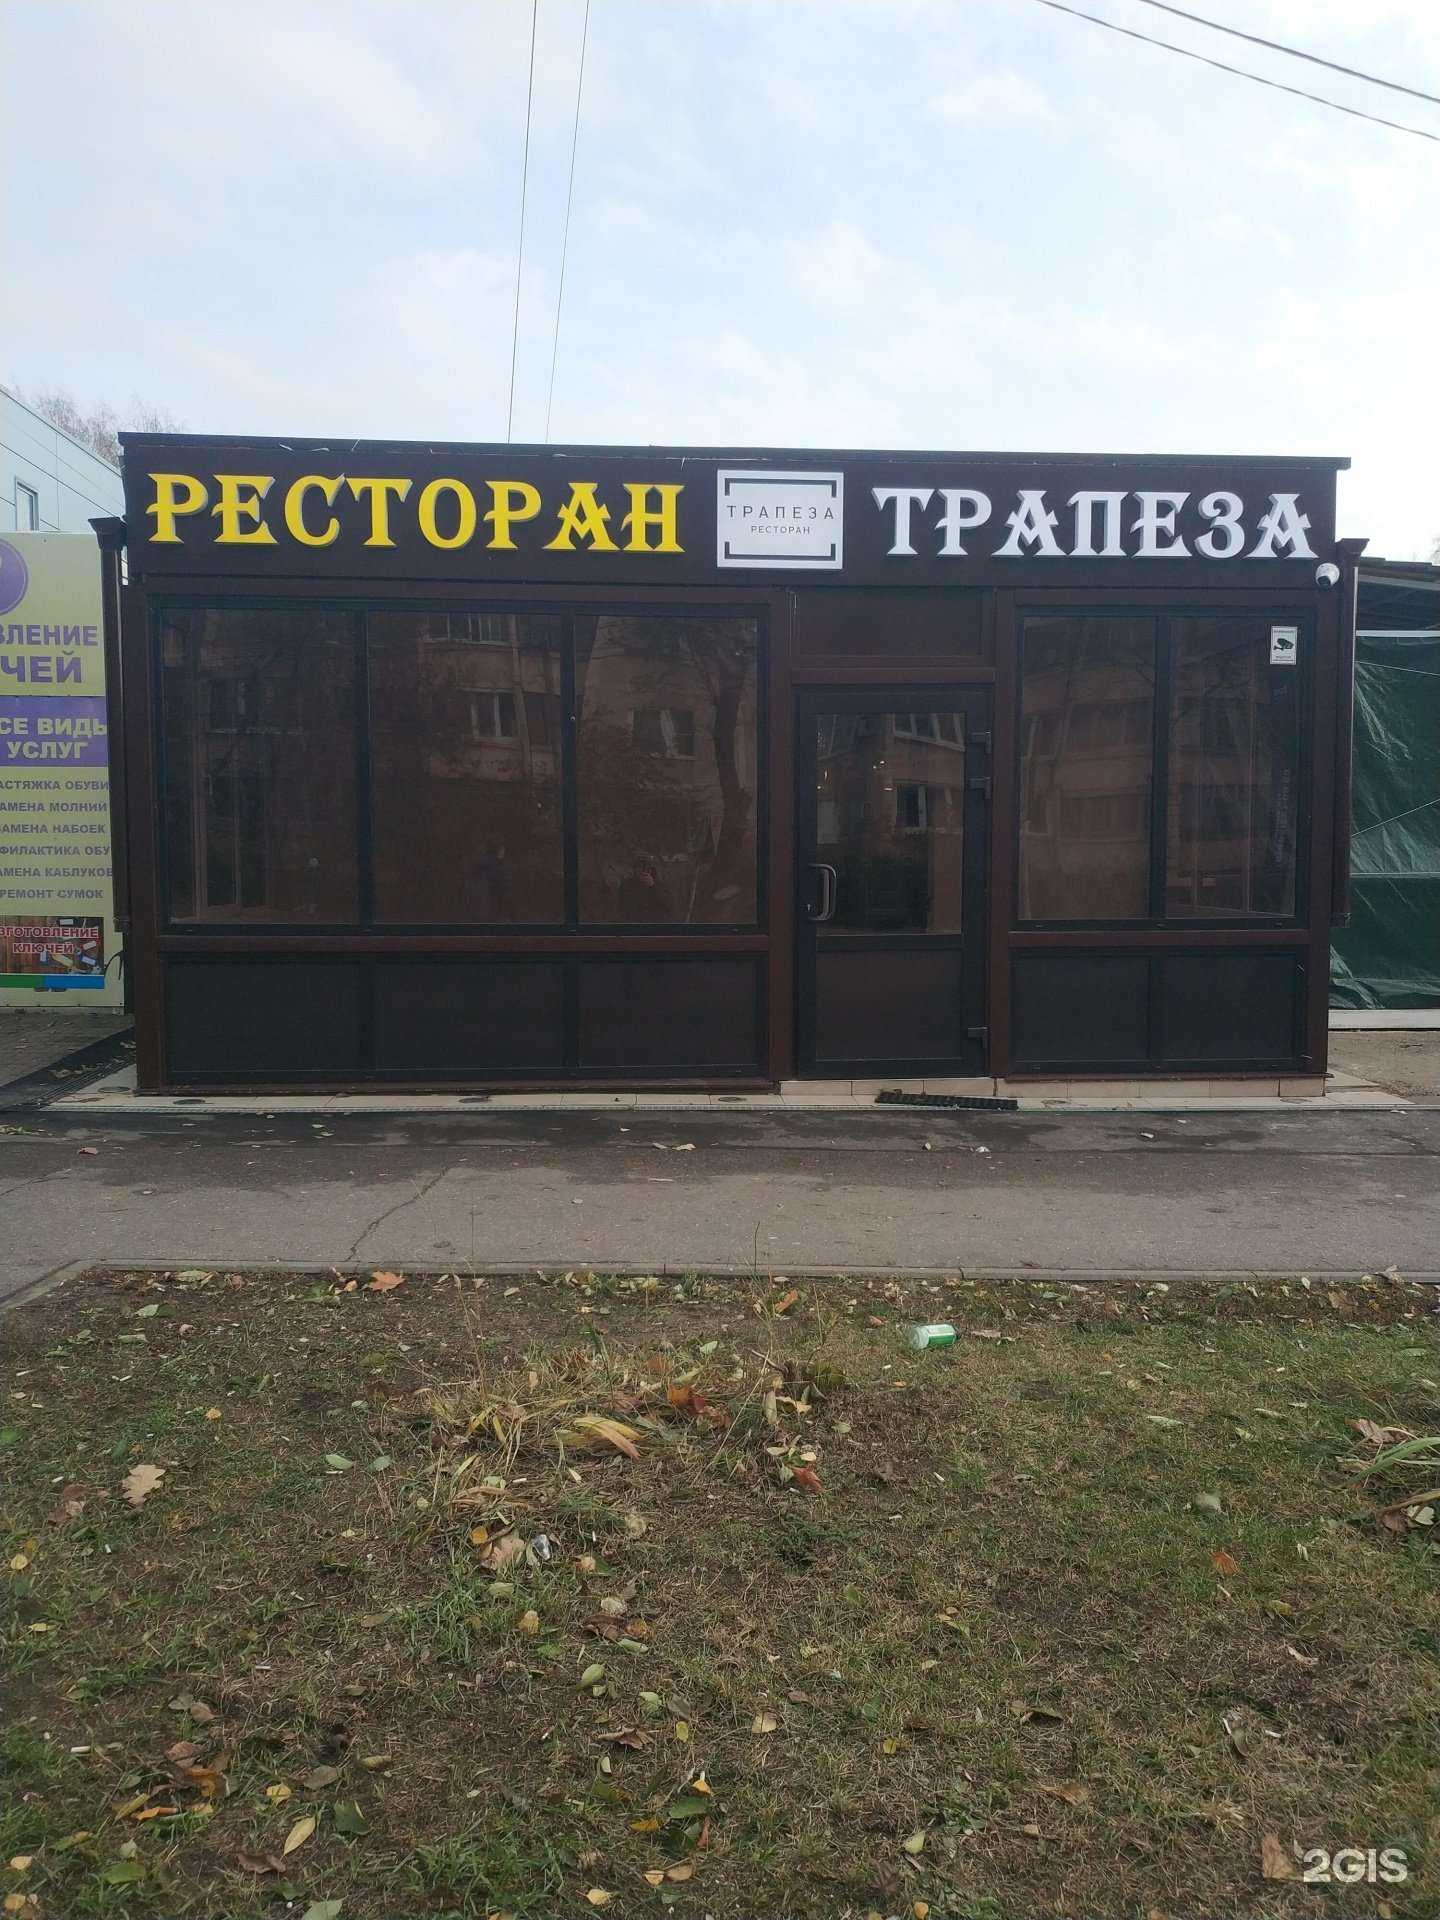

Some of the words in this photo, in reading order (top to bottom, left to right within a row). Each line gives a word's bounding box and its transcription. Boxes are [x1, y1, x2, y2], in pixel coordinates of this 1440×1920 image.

[145, 473, 687, 552] РЕСТОРАН
[727, 505, 834, 519] ТРАПЕЗА
[751, 525, 810, 534] РЕСТОРАН
[872, 487, 1319, 559] ТРАПЕЗА
[0, 650, 82, 683] ЧЕЙ
[7, 741, 88, 759] УСЛУГ
[0, 824, 48, 833] АМЕНА
[53, 824, 105, 833] НАБОЕК
[0, 889, 53, 899] РЕМОНТ
[57, 889, 103, 899] СУМОК
[13, 942, 74, 954] КЛЮЧЕЙ
